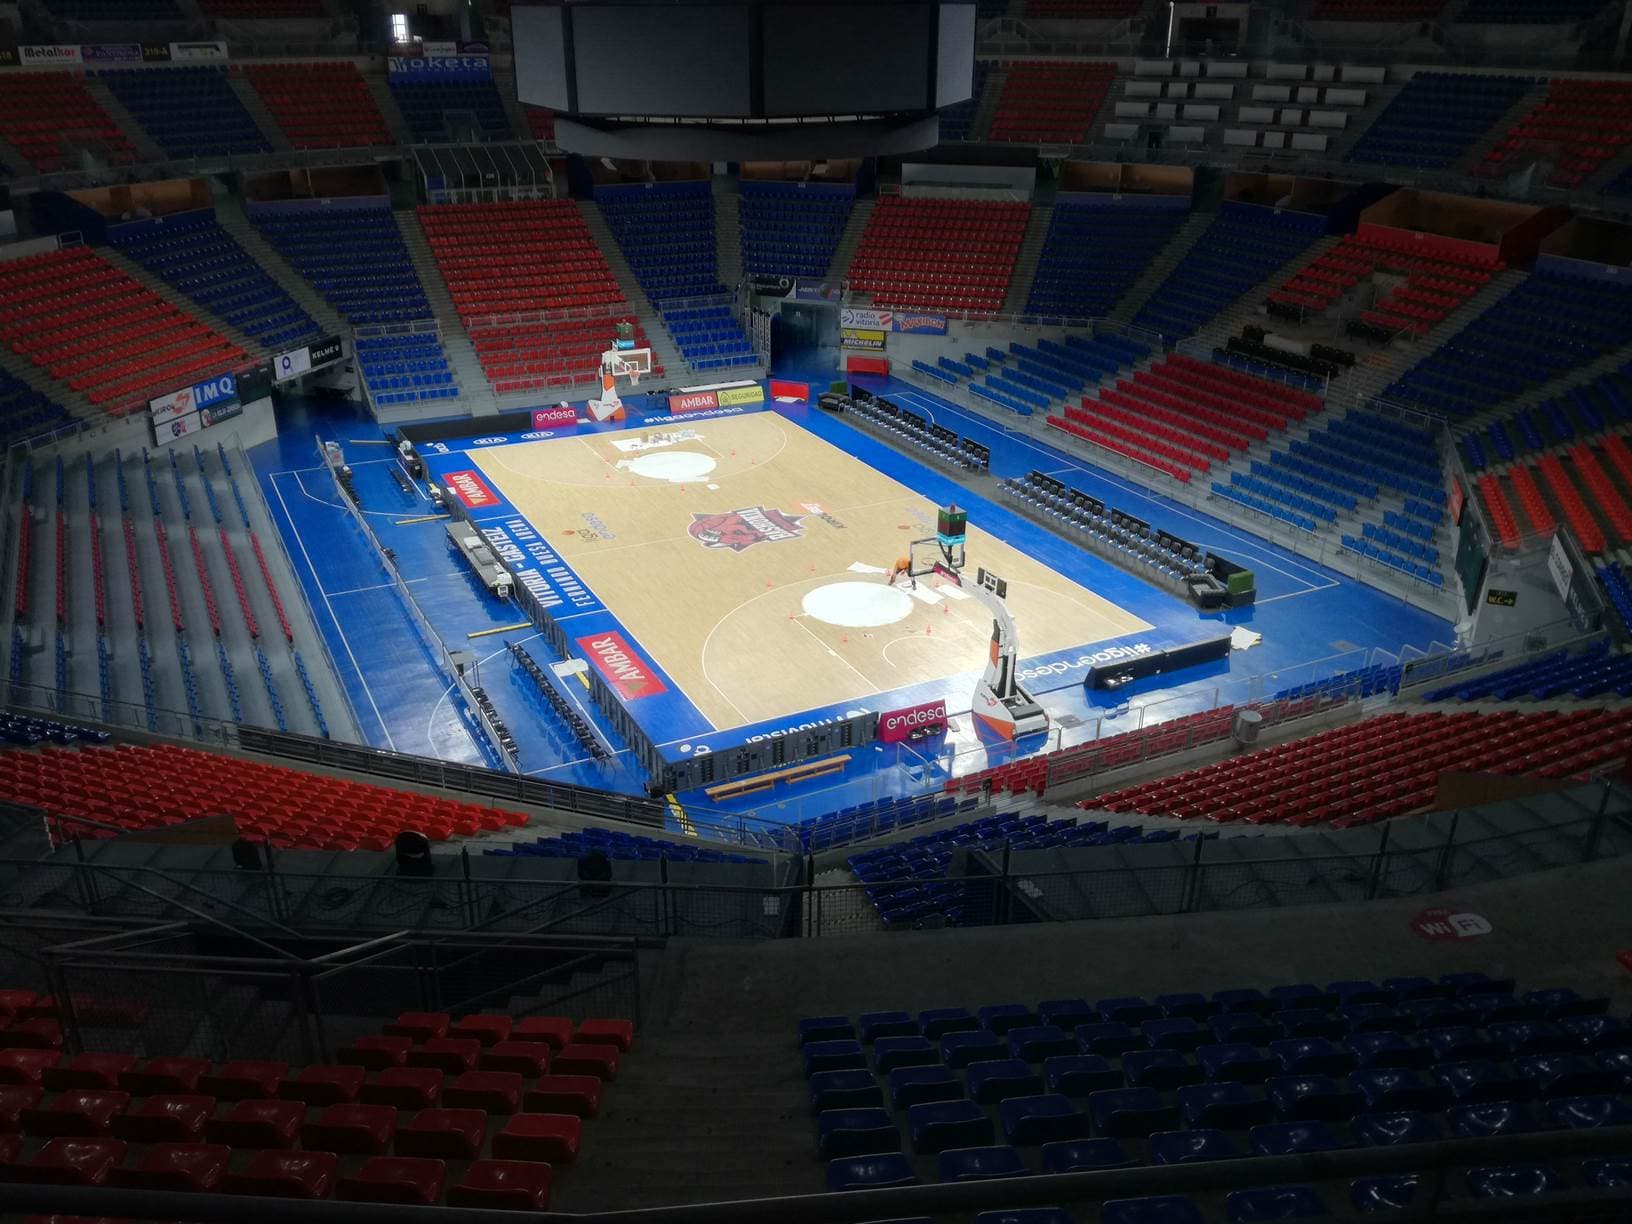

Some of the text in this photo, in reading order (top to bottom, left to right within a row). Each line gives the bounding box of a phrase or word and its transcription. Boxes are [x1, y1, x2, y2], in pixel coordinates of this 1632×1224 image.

[855, 310, 876, 320] radio
[855, 318, 880, 328] vitoria
[312, 346, 335, 360] KELME
[843, 338, 882, 347] MICHELIN
[195, 377, 235, 404] IMQ
[680, 395, 715, 409] AMBAR
[536, 409, 575, 421] endesa
[452, 473, 487, 501] AMBAR
[504, 518, 537, 541] ARENA
[480, 526, 526, 563] GASTEIZ
[524, 541, 559, 566] BUESA
[516, 568, 563, 609] VITORIA
[546, 566, 596, 607] FERNANDO
[591, 636, 646, 681] AMBAR
[886, 704, 946, 730] endesa
